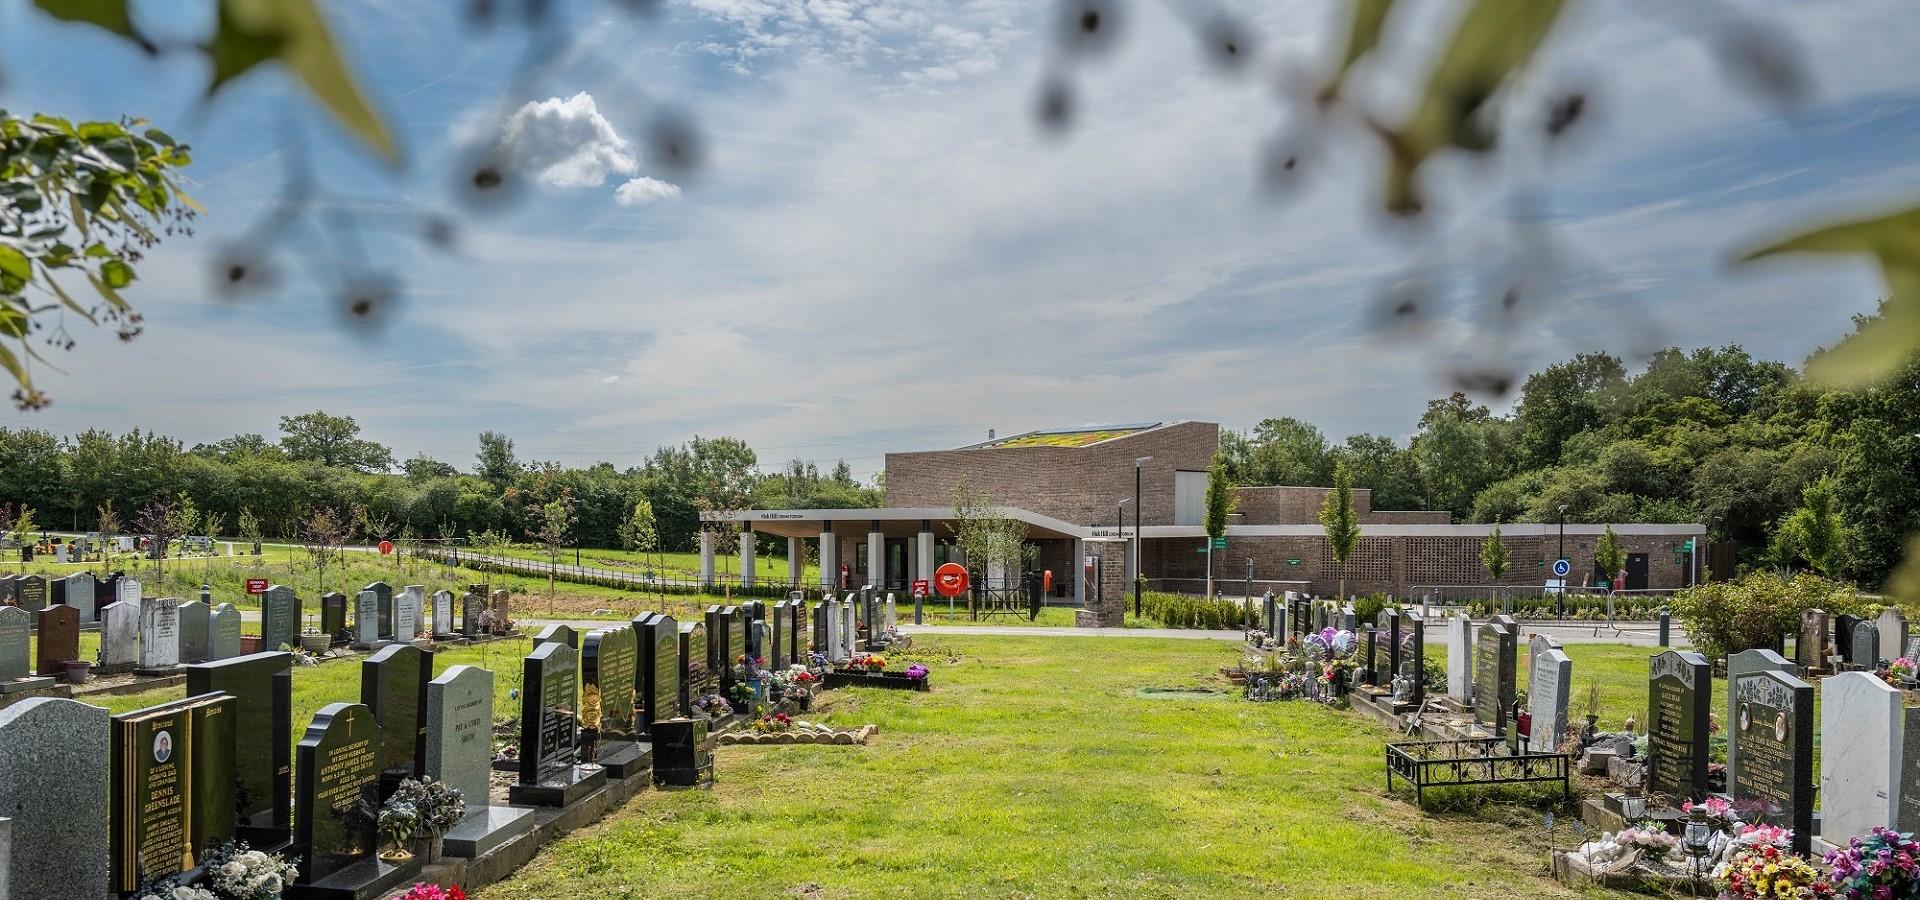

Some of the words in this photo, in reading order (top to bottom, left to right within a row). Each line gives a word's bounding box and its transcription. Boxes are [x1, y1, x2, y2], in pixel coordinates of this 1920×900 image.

[321, 761, 344, 776] ANTHONY
[360, 752, 375, 762] FROST
[152, 786, 174, 800] DENNIS
[144, 794, 180, 814] GREENSLADE
